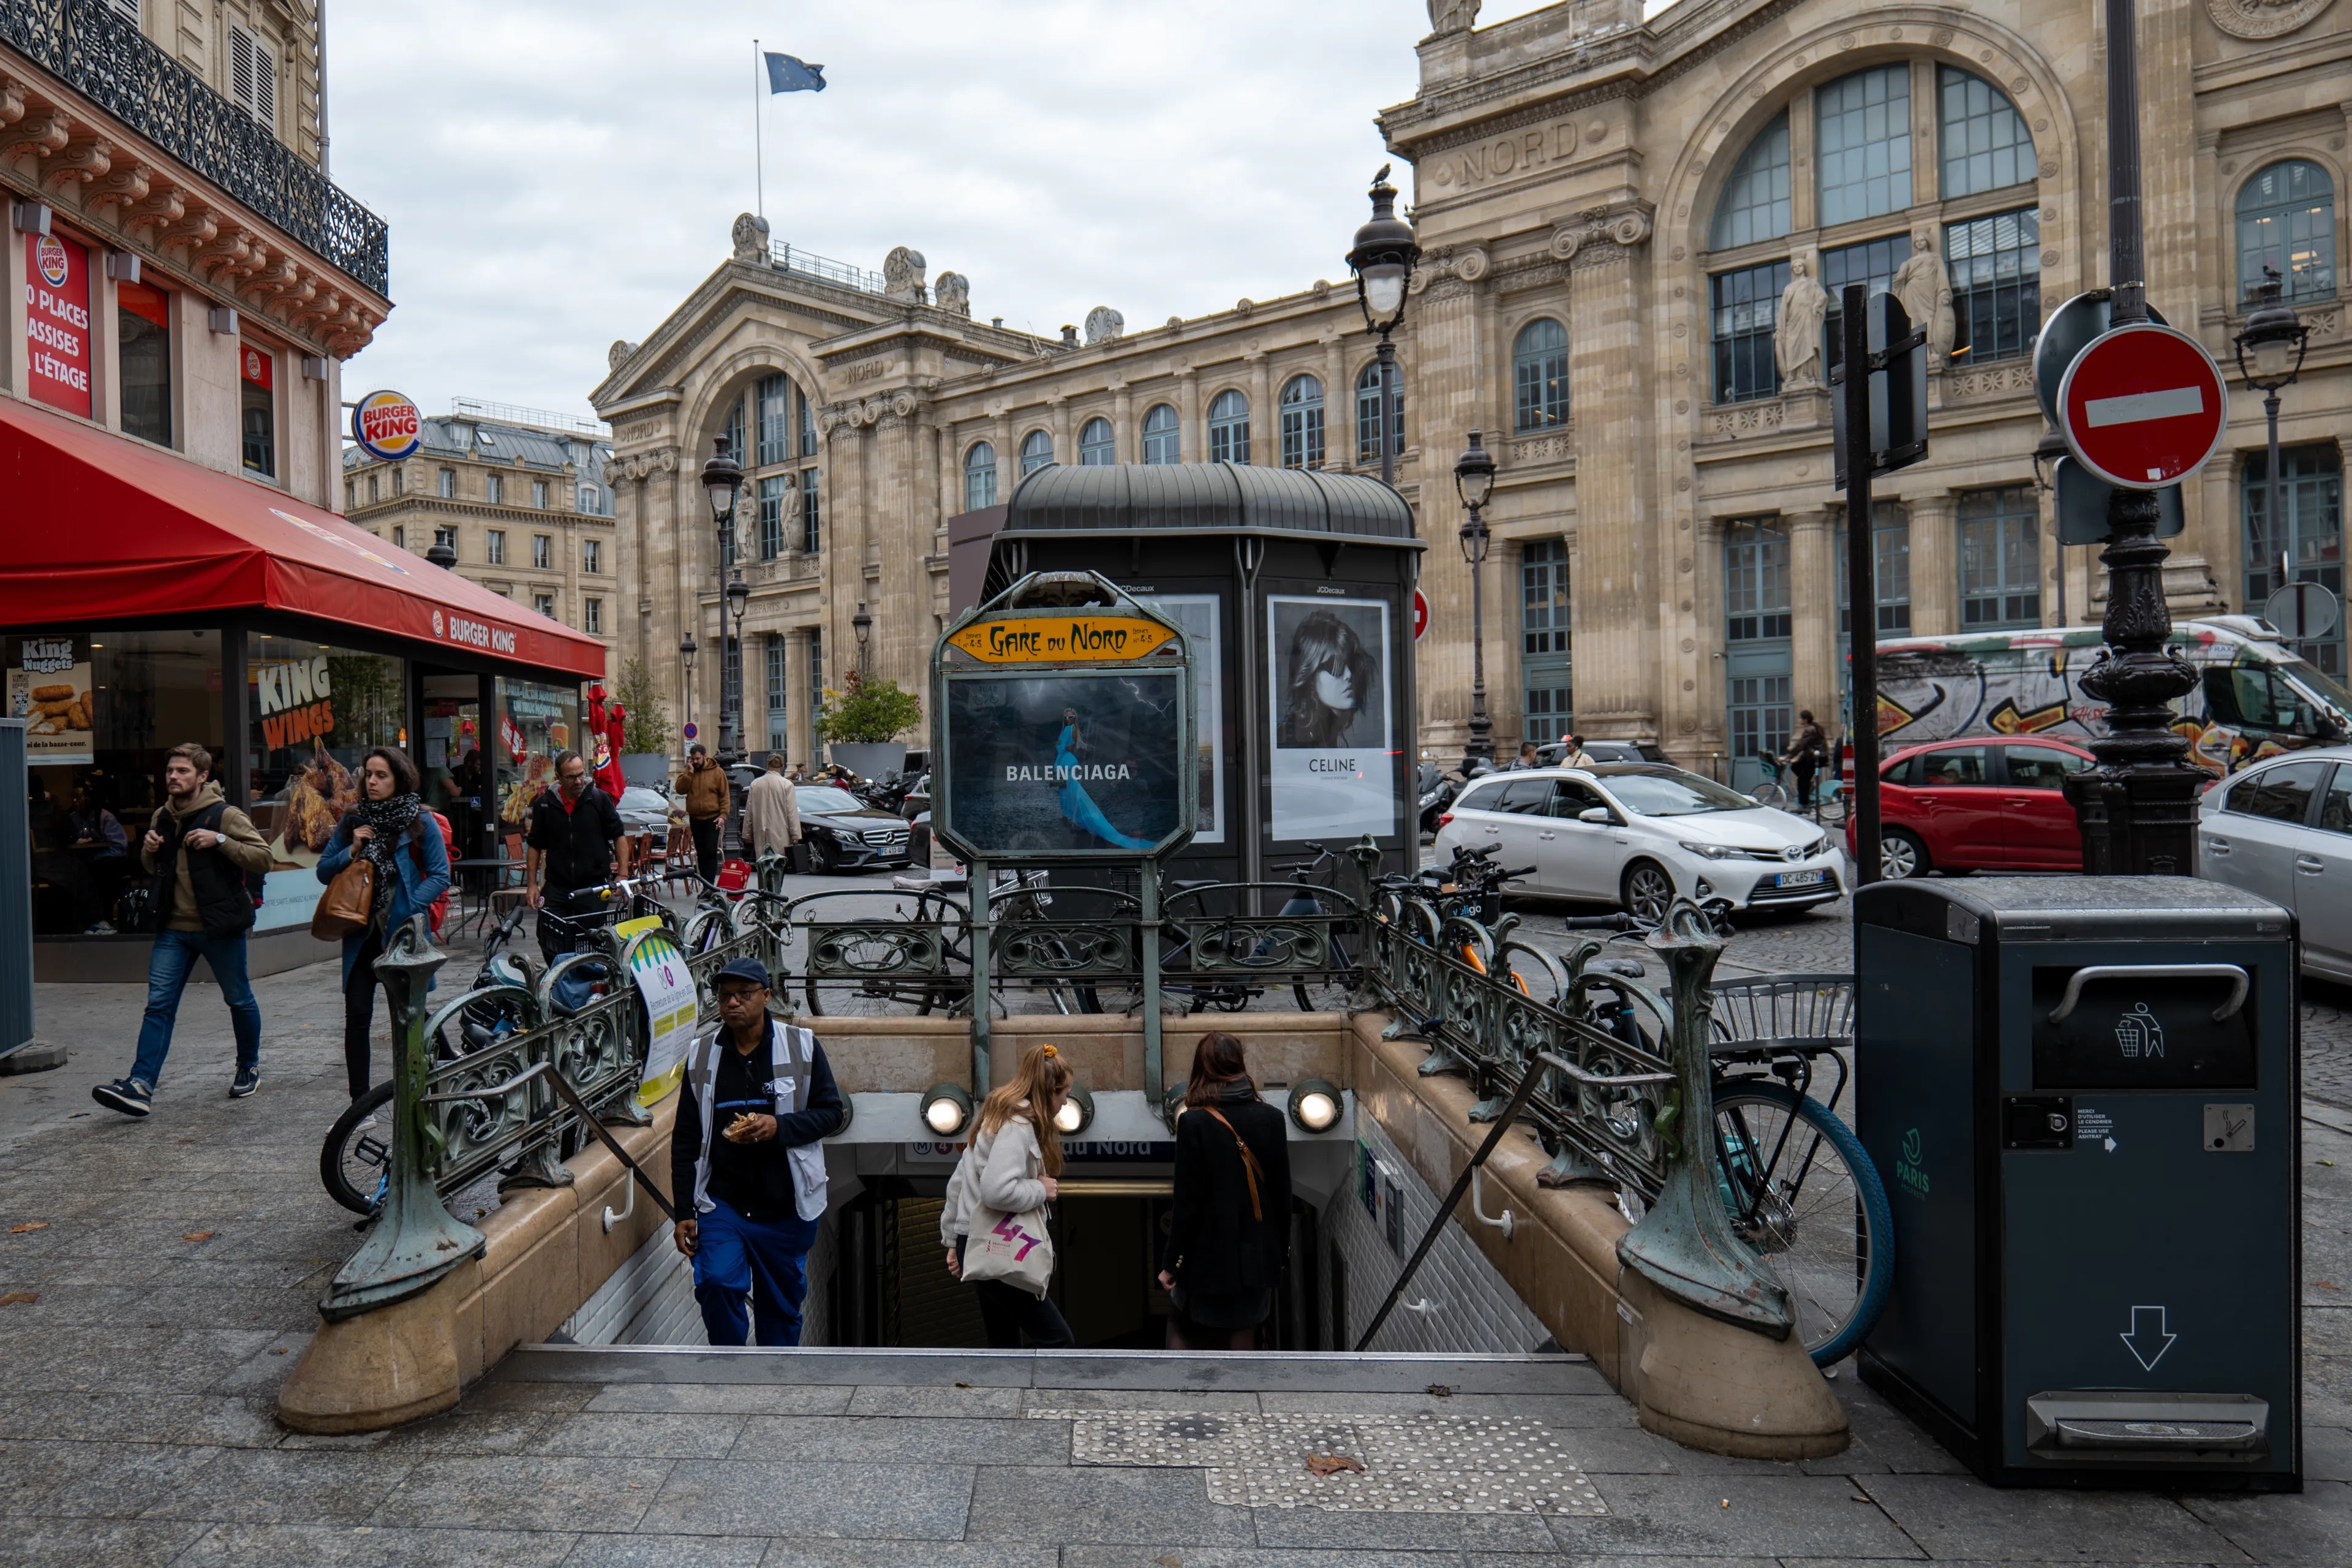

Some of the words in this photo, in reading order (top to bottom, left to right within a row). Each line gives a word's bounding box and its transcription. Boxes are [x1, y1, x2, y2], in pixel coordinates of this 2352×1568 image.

[1460, 121, 1578, 186] NORD
[41, 247, 63, 257] BURGER
[43, 257, 65, 270] KING
[40, 289, 88, 330] PLACES
[28, 317, 79, 356] ASSISES
[36, 352, 88, 392] L'ÉTAGE
[848, 360, 884, 384] NORD
[363, 405, 415, 424] BURGER
[366, 417, 417, 442] KING
[1316, 586, 1345, 595] JCDecaux
[749, 601, 780, 615] DEPARTS
[450, 616, 489, 648] BURGER
[492, 627, 515, 654] KING
[989, 625, 1041, 657] GARE
[1071, 623, 1127, 654] NORD
[22, 638, 73, 660] King
[23, 658, 74, 674] Nuggets
[258, 655, 331, 715] KING
[513, 699, 521, 712] UN
[521, 701, 535, 714] TRUC
[535, 703, 551, 716] MOINS
[262, 699, 334, 752] WINGS
[1006, 764, 1131, 782] BALENCIAGA
[1309, 758, 1356, 772] CELINE
[1782, 872, 1819, 884] DC-485-ZY
[650, 997, 667, 1011] Fermeture
[666, 993, 671, 1004] de
[670, 992, 675, 1001] la
[674, 990, 682, 1002] ligne
[685, 984, 694, 995] 2022
[1096, 1142, 1151, 1155] Nord
[1897, 1159, 1929, 1193] PARIS
